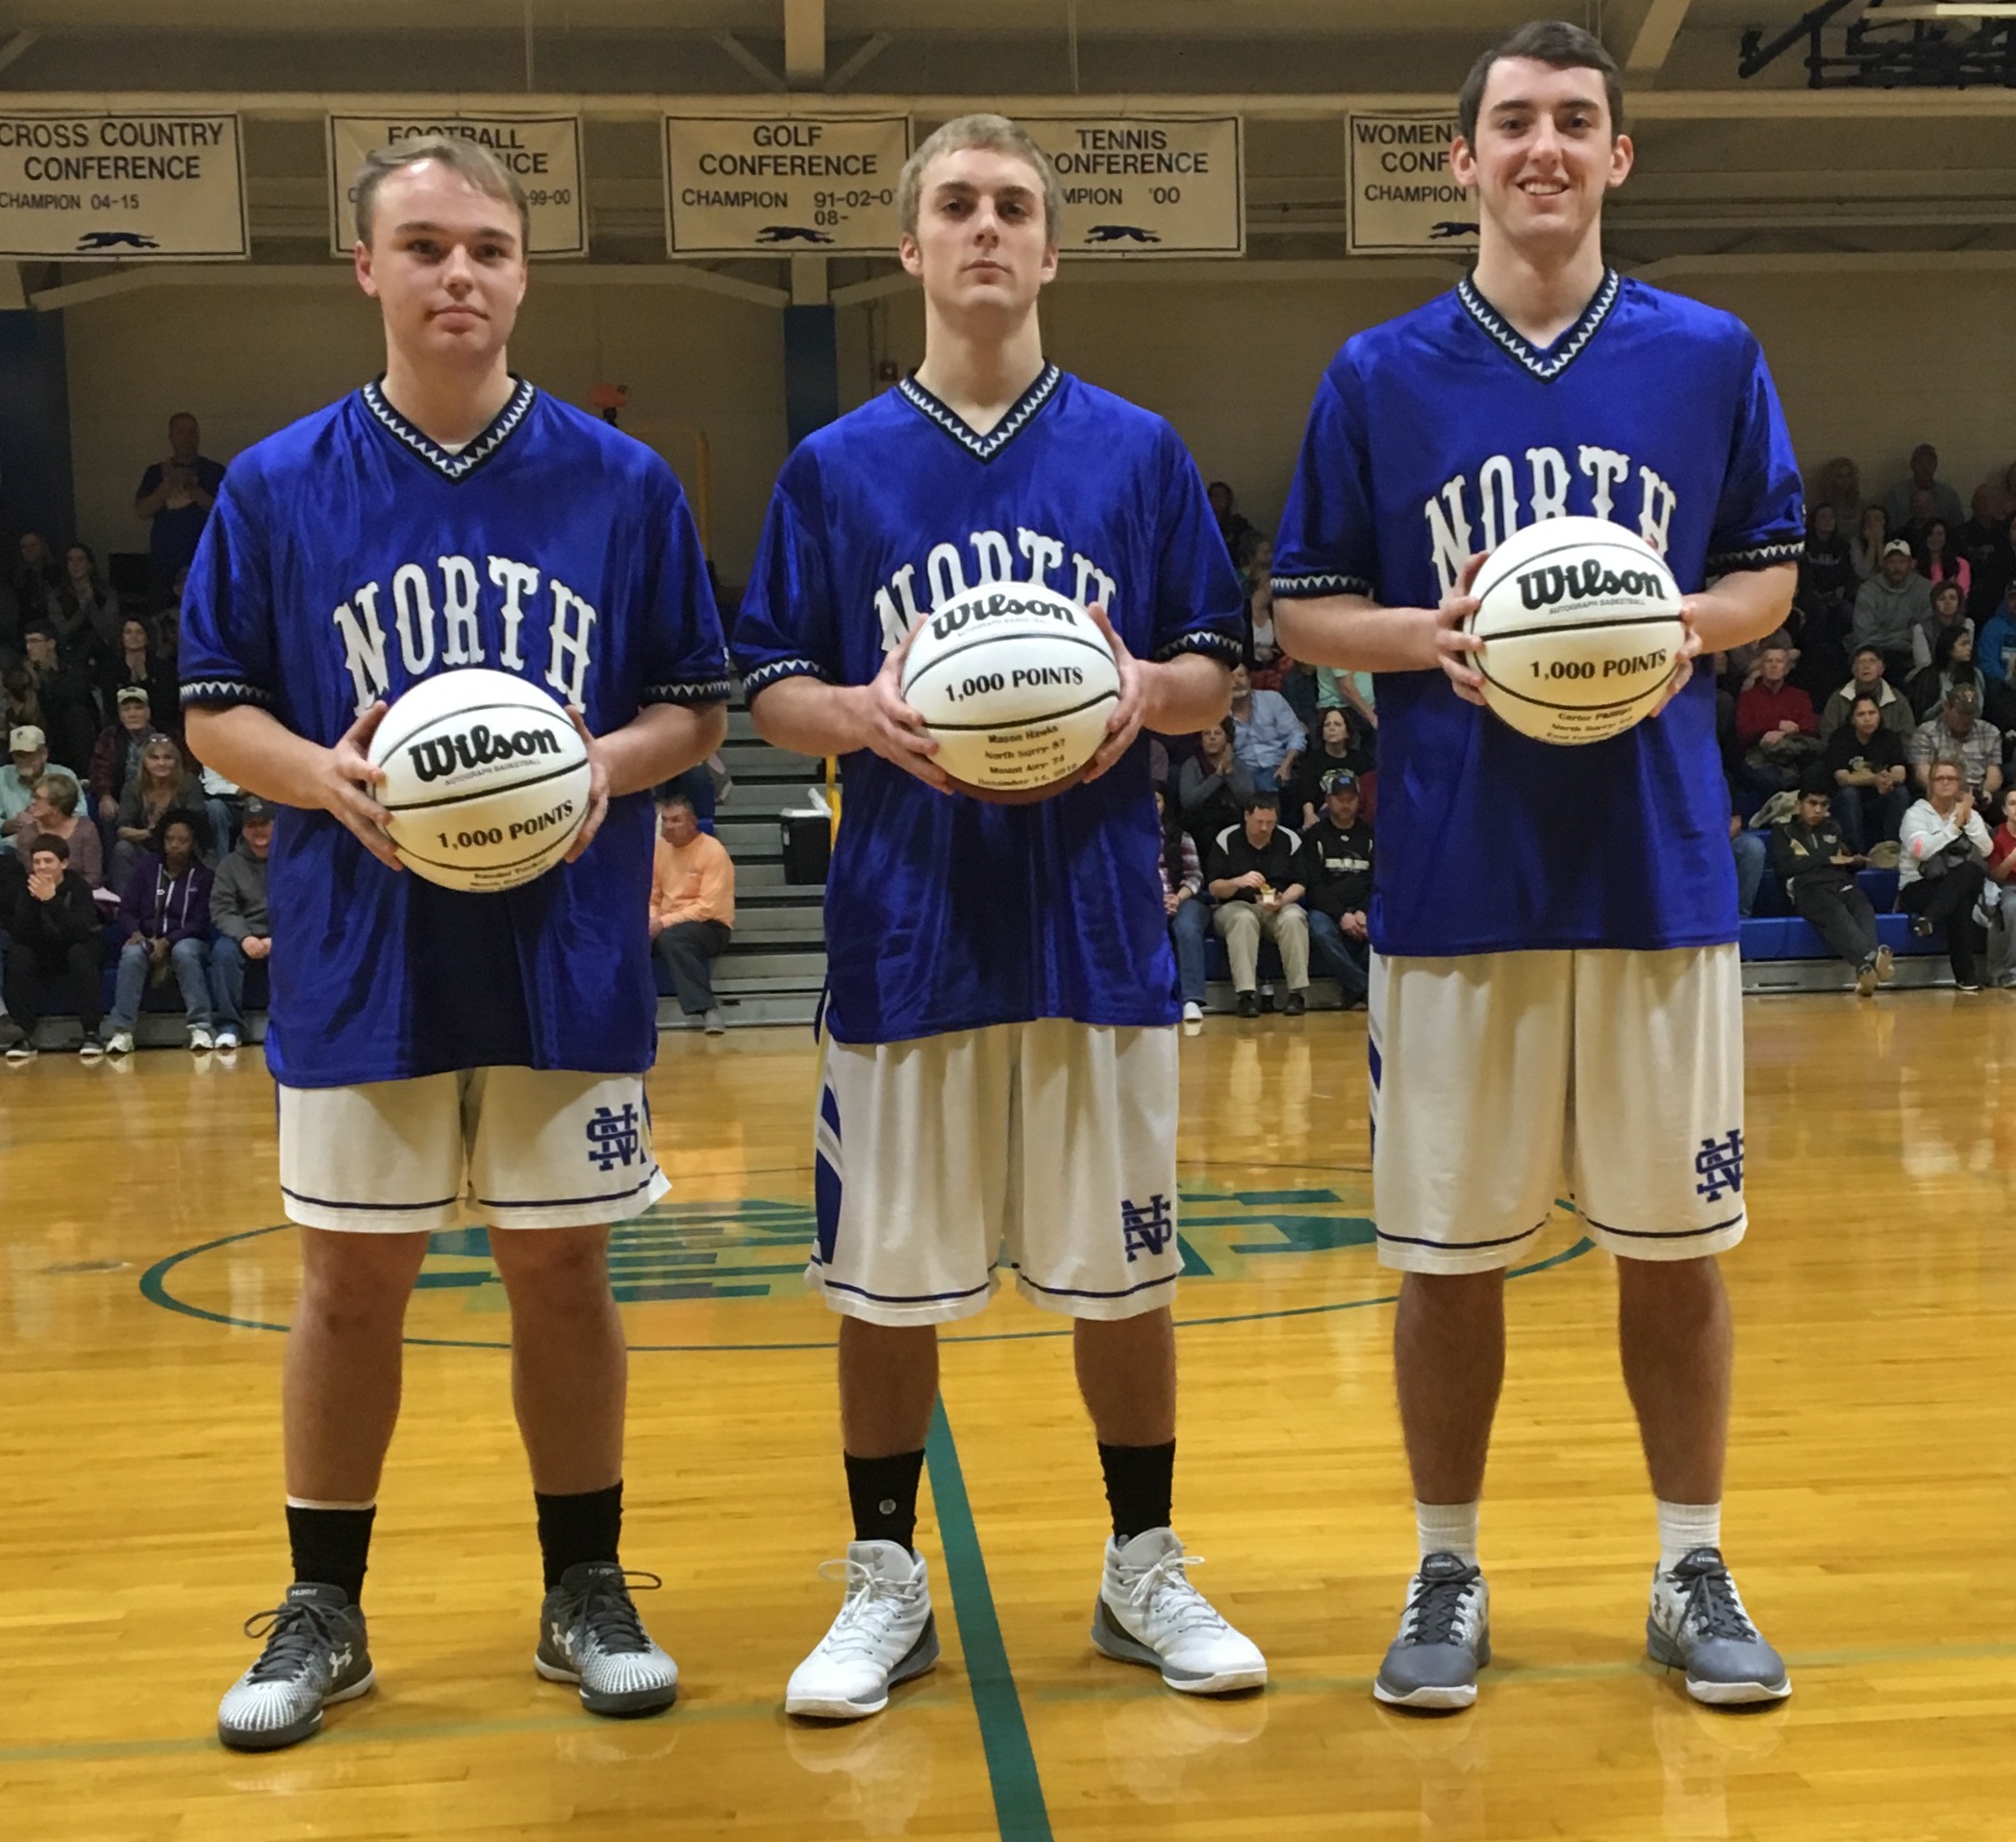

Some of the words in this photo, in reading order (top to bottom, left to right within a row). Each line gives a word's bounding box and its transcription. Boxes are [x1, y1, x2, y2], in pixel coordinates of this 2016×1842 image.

[0, 122, 89, 148] CROSS
[100, 122, 224, 147] COUNTRY
[753, 125, 822, 147] GOLF
[1075, 129, 1169, 151] TENNIS
[1356, 123, 1459, 145] WOMEN
[24, 155, 201, 182] CONFERENCE
[699, 154, 877, 176] CONFERENCE
[1047, 152, 1209, 175] ONFERENCE
[0, 192, 82, 210] CHAMPION
[90, 193, 140, 211] 04-15
[682, 189, 789, 209] CHAMPION
[814, 189, 897, 209] 91-02-0
[1062, 187, 1122, 206] MPION
[1364, 184, 1468, 203] CHAMPION
[1424, 444, 1677, 610] NORTH
[1516, 559, 1667, 611] Wilson
[931, 593, 1078, 642] Wilson
[333, 555, 597, 718] NORTH
[1530, 661, 1596, 681] 1,000
[1602, 648, 1668, 678] POINTS
[945, 672, 1004, 703] 1,000
[1012, 667, 1084, 689] POINTS
[408, 725, 563, 783] Wilson
[437, 828, 503, 851] 1,000
[509, 798, 574, 841] POINTS
